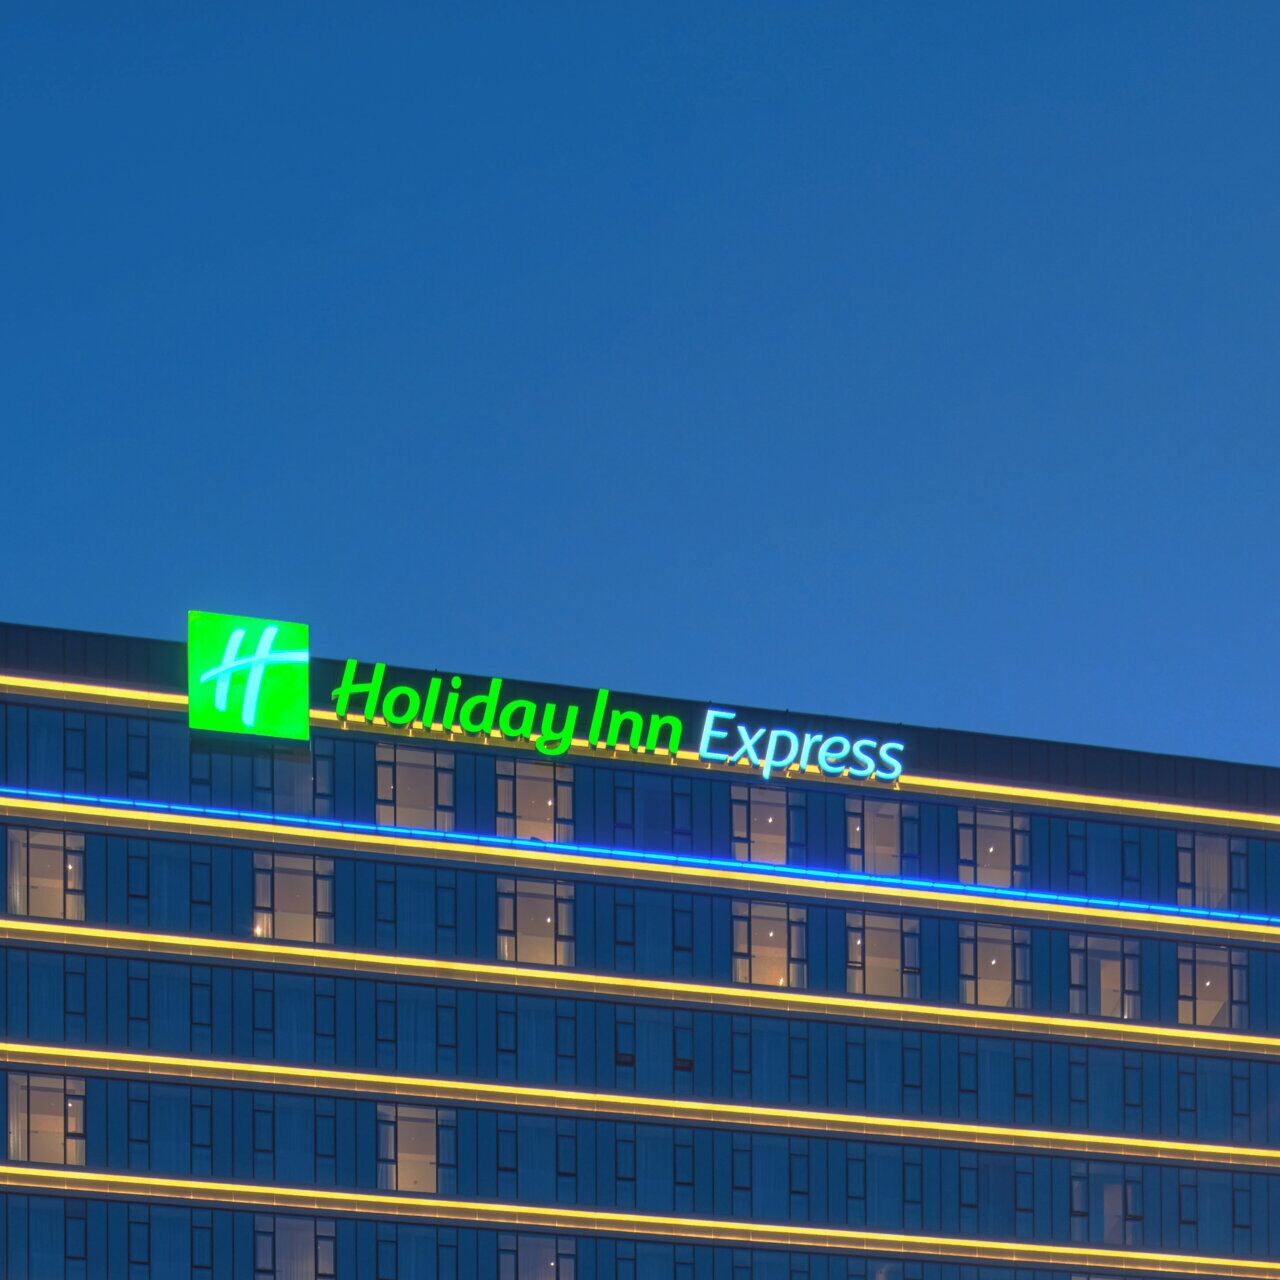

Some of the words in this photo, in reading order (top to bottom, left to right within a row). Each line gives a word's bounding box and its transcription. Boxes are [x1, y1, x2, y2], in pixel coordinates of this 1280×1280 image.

[331, 658, 579, 756] Holiday
[588, 688, 683, 754] Inn
[698, 708, 905, 781] Express
